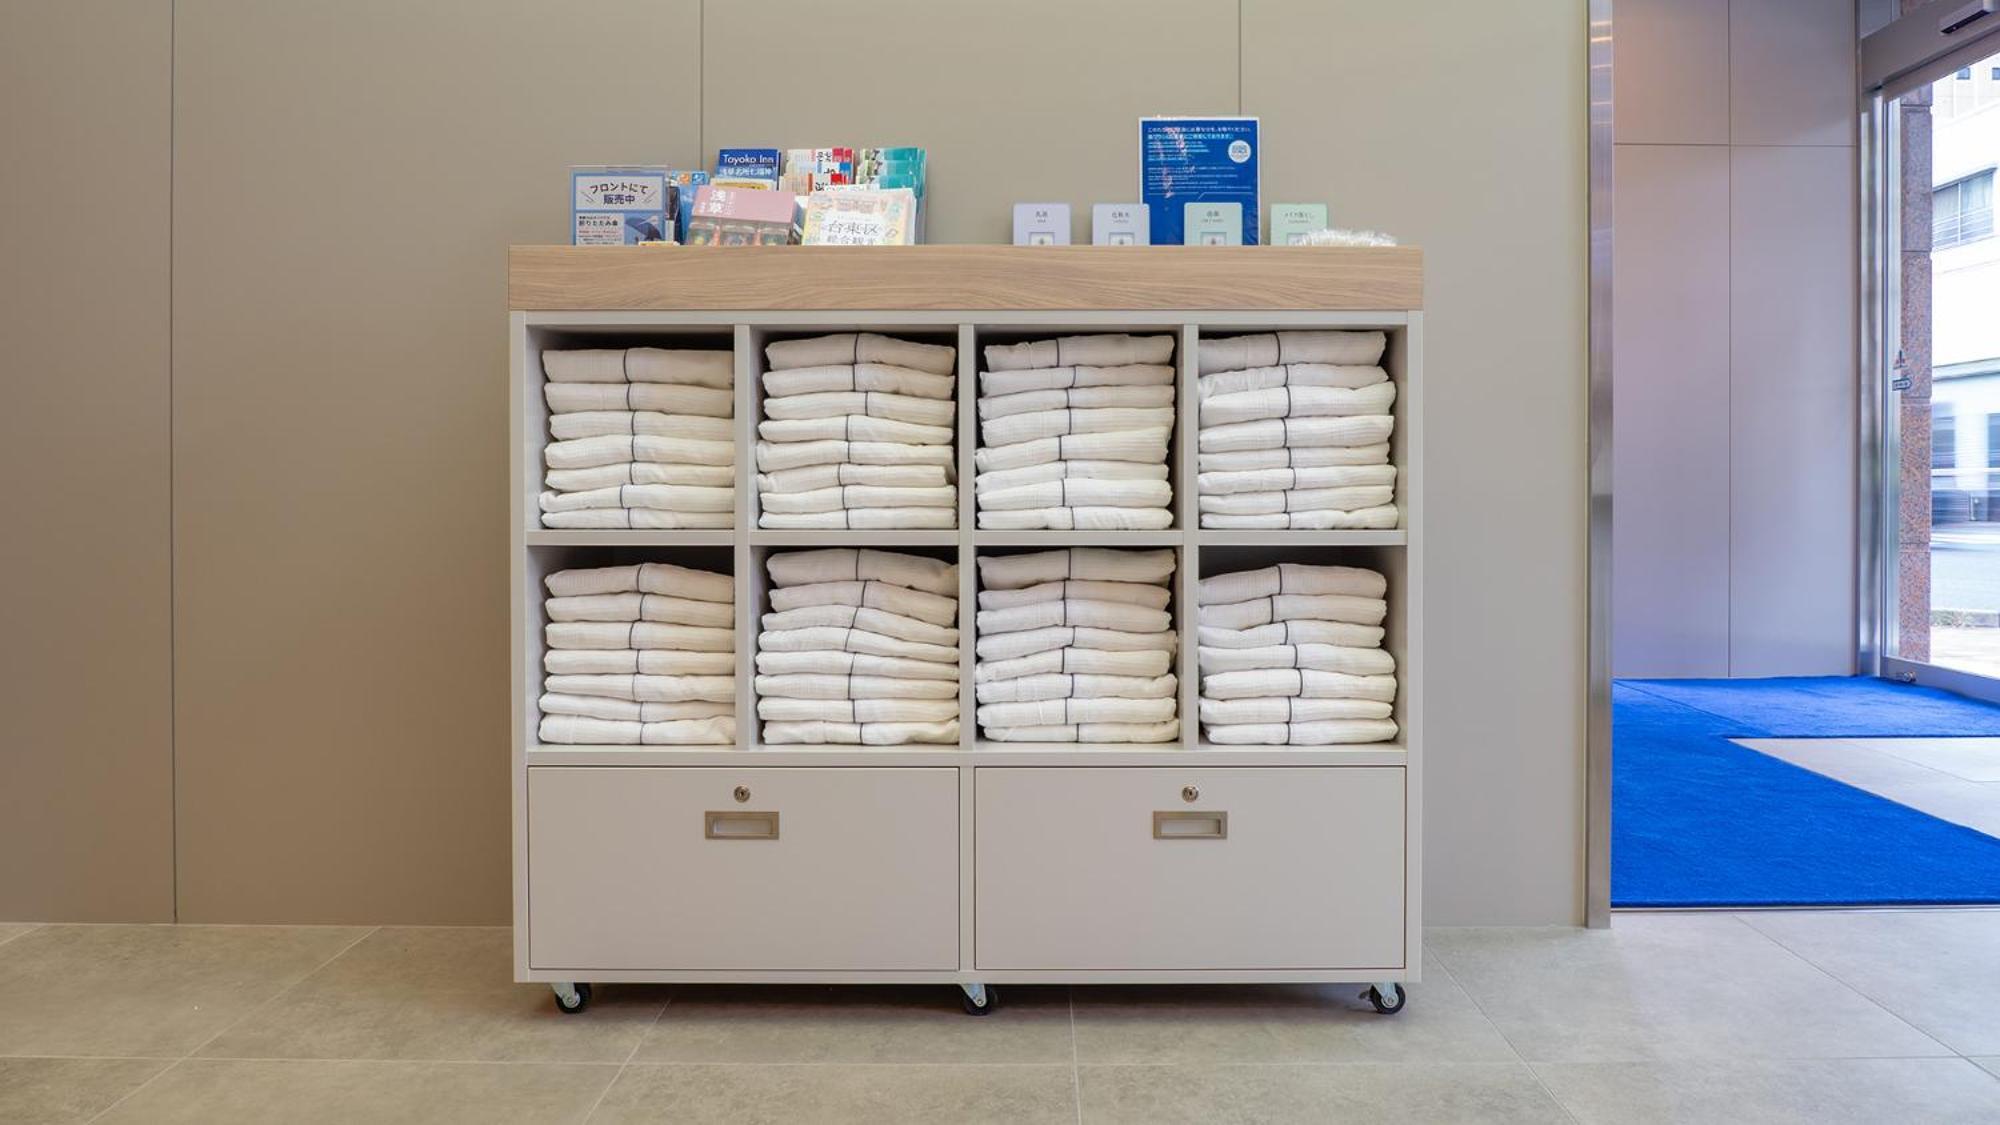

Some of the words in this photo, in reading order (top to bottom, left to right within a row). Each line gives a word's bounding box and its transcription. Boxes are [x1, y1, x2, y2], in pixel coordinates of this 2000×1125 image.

[723, 154, 757, 165] Toyoko
[759, 155, 774, 163] Inn
[590, 182, 649, 195] フロントにて
[603, 193, 636, 205] 販売中
[709, 190, 727, 214] 浅草
[828, 220, 881, 236] 台東区
